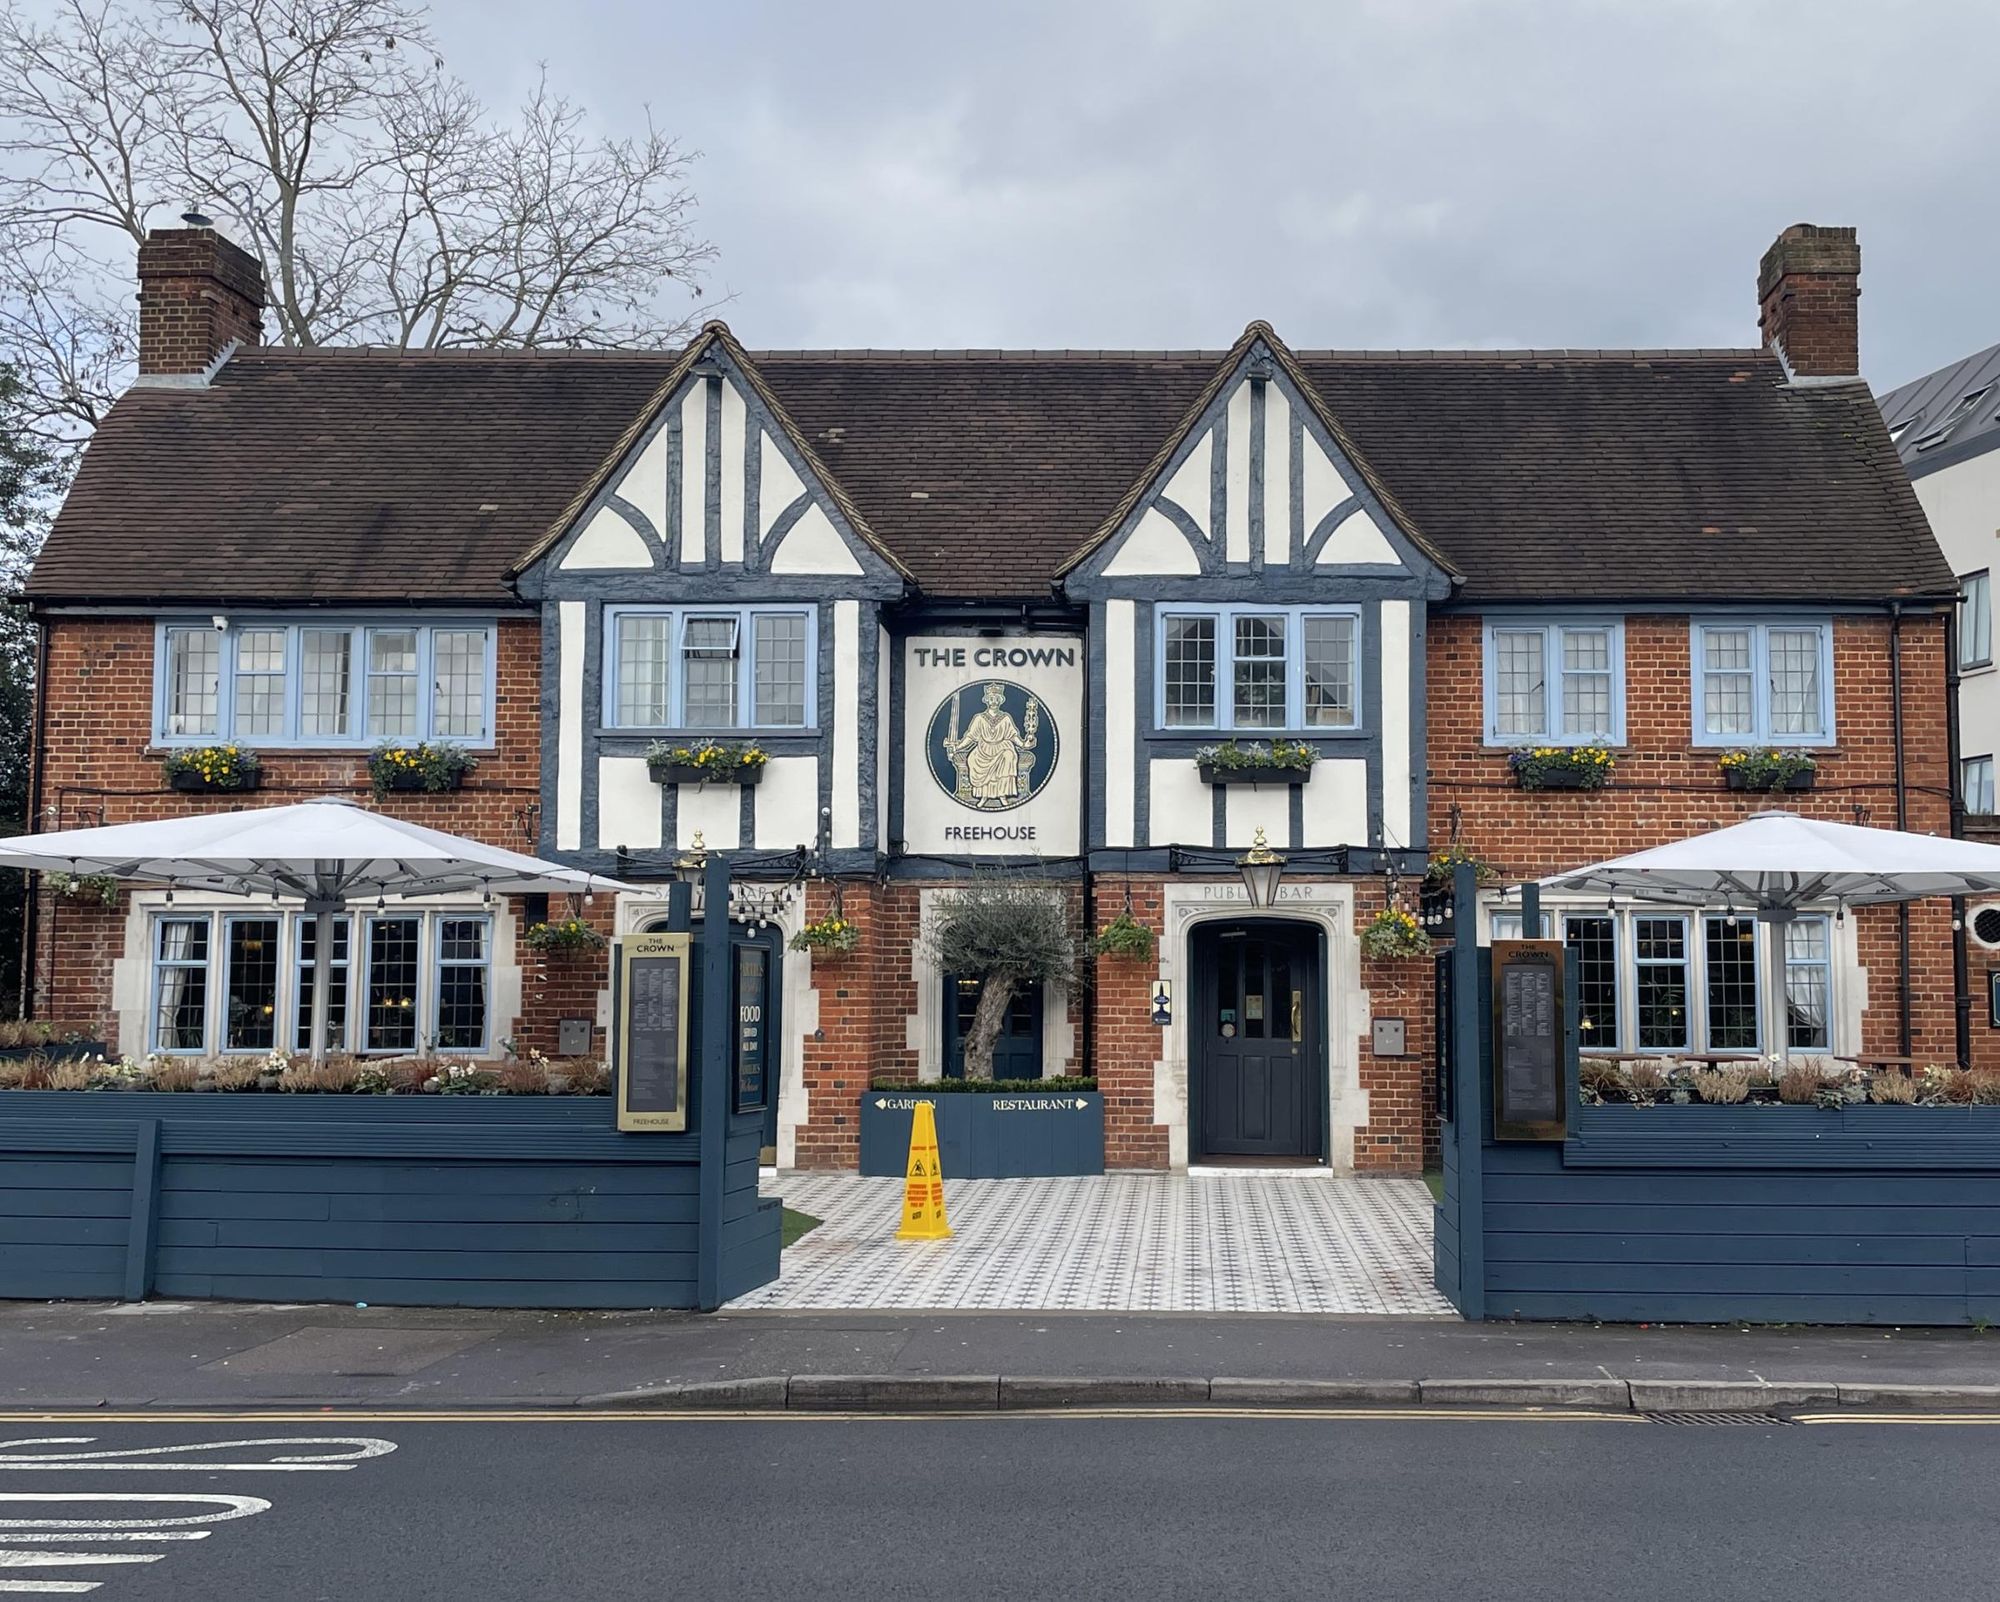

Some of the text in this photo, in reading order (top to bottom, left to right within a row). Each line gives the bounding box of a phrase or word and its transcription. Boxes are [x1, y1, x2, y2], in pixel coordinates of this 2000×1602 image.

[914, 647, 1075, 668] THE CROWN
[945, 826, 1036, 840] FREEHOUSE
[1203, 886, 1313, 899] PUBL BAR
[636, 944, 675, 953] CROWN
[1508, 950, 1549, 958] CROWN
[740, 1005, 761, 1023] FOOD
[993, 1099, 1074, 1111] RESTAURANT
